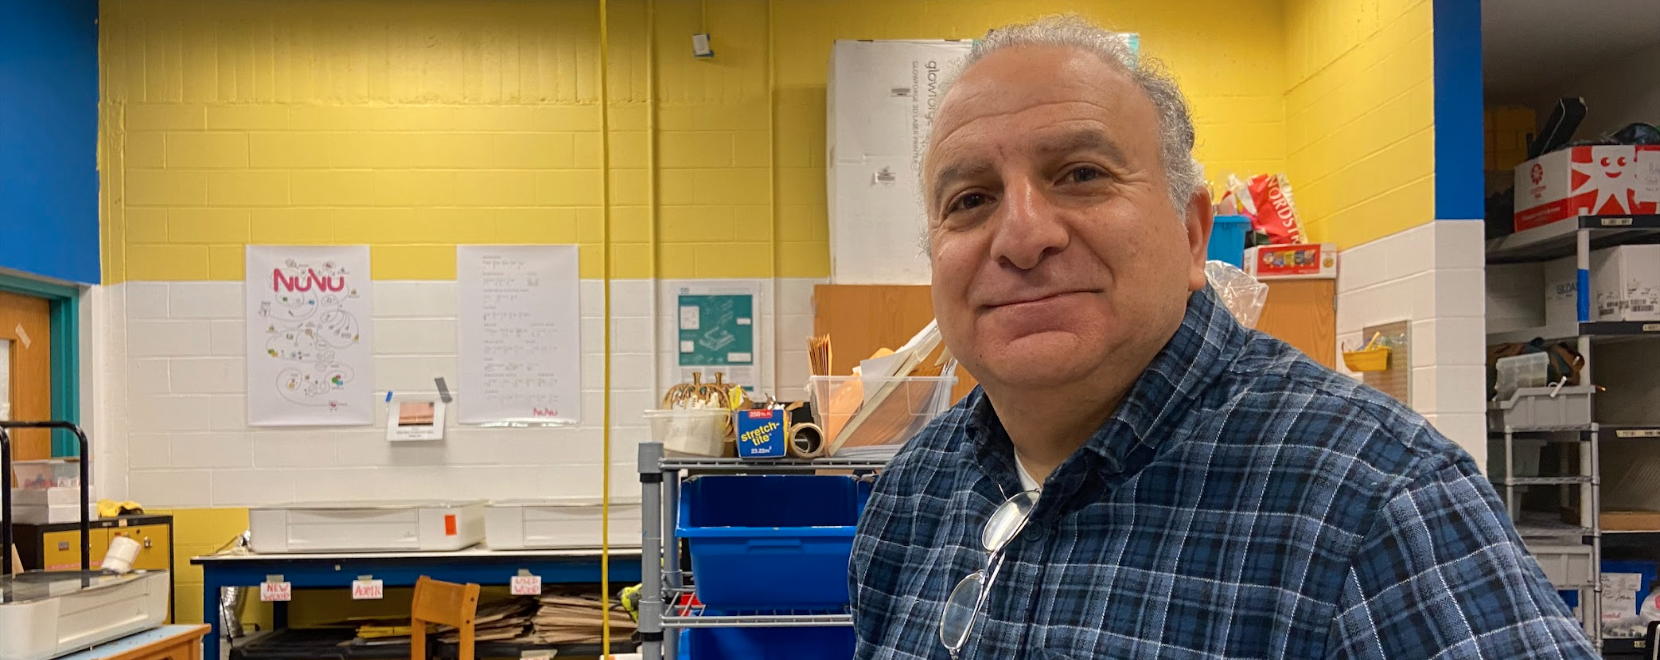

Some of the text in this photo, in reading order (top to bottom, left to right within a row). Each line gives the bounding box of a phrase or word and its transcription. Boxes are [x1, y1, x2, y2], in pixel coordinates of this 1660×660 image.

[911, 115, 919, 135] LASER
[267, 582, 289, 592] NEW
[514, 585, 540, 594] WOOD
[263, 592, 290, 601] WOOD
